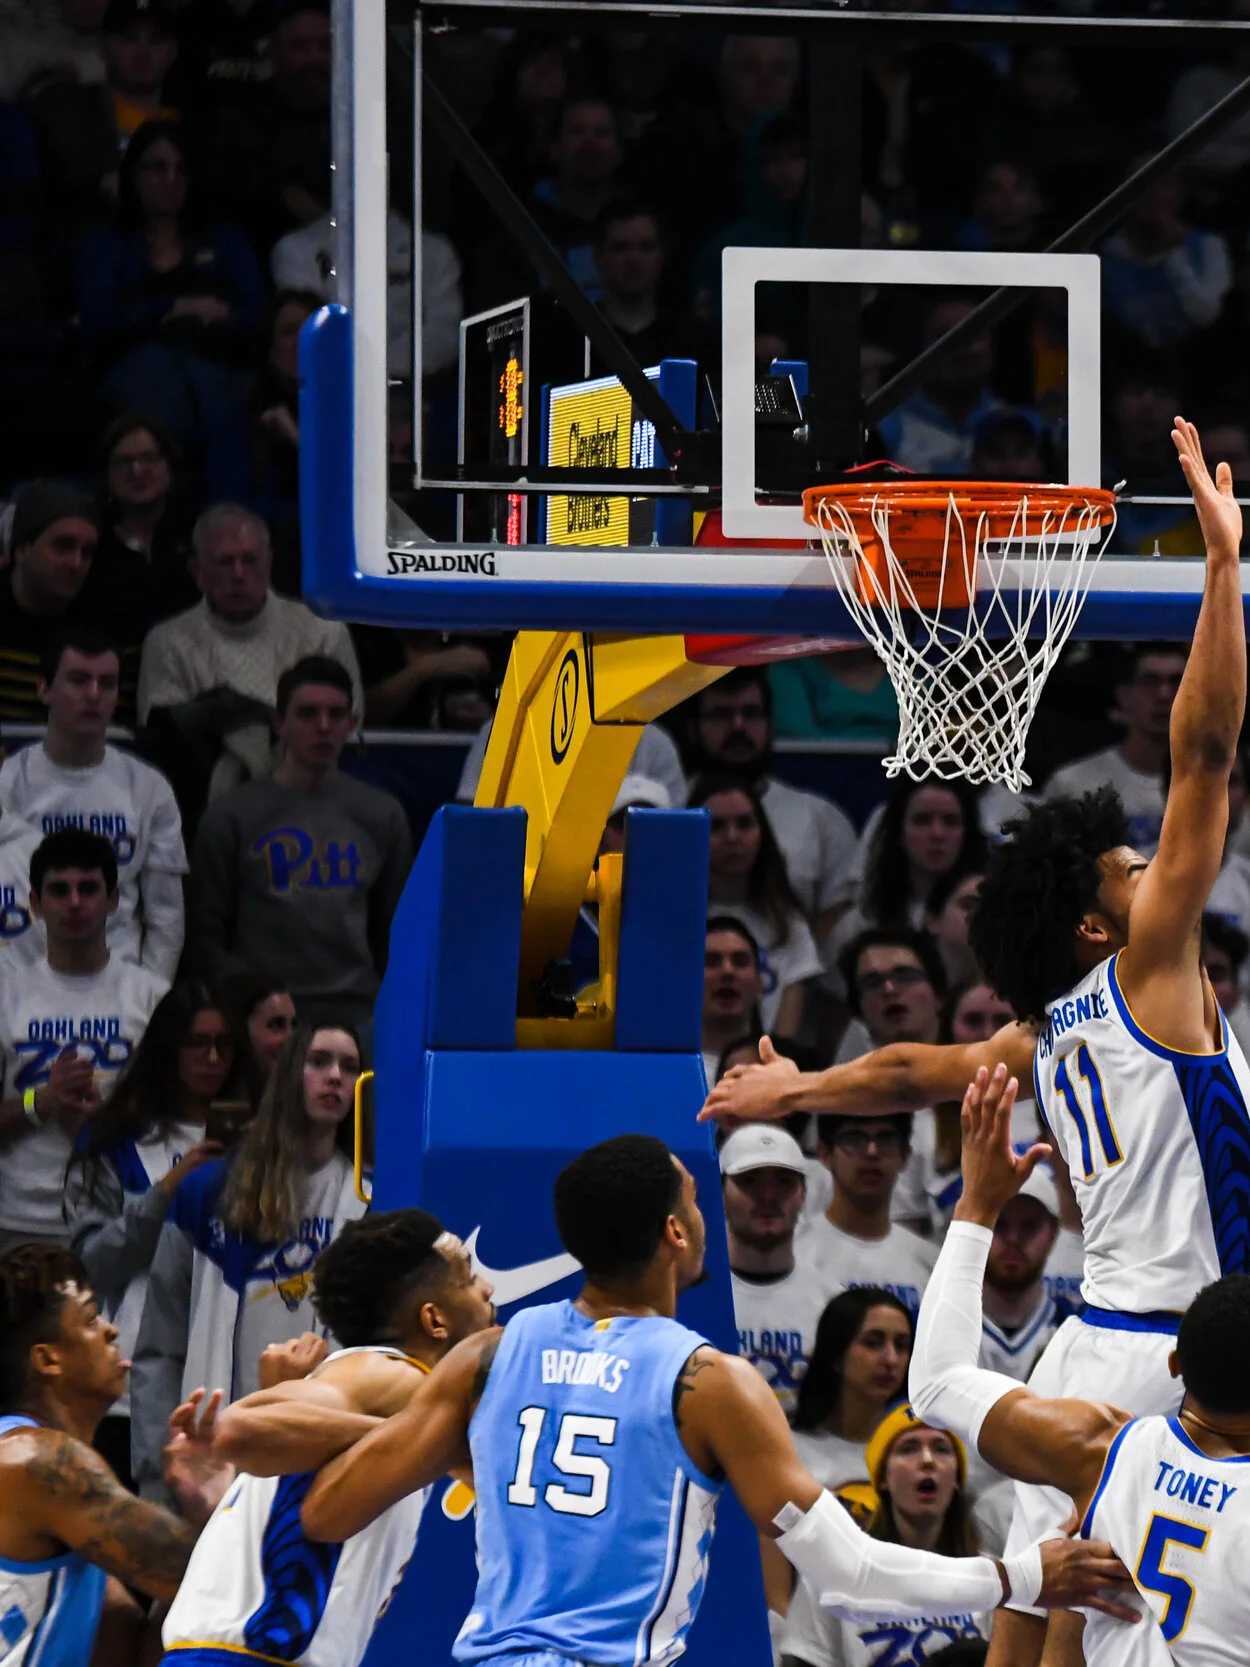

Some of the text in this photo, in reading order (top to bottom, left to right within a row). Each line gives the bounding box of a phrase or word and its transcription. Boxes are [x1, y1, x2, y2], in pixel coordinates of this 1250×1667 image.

[387, 552, 496, 576] SPALDING
[252, 827, 362, 893] Pitt
[28, 1017, 120, 1040] OAKLAND
[1054, 1040, 1125, 1182] 11
[541, 1349, 631, 1393] BROOKS
[507, 1405, 619, 1517] 15
[1154, 1461, 1237, 1512] TONEY
[1133, 1511, 1212, 1644] 5
